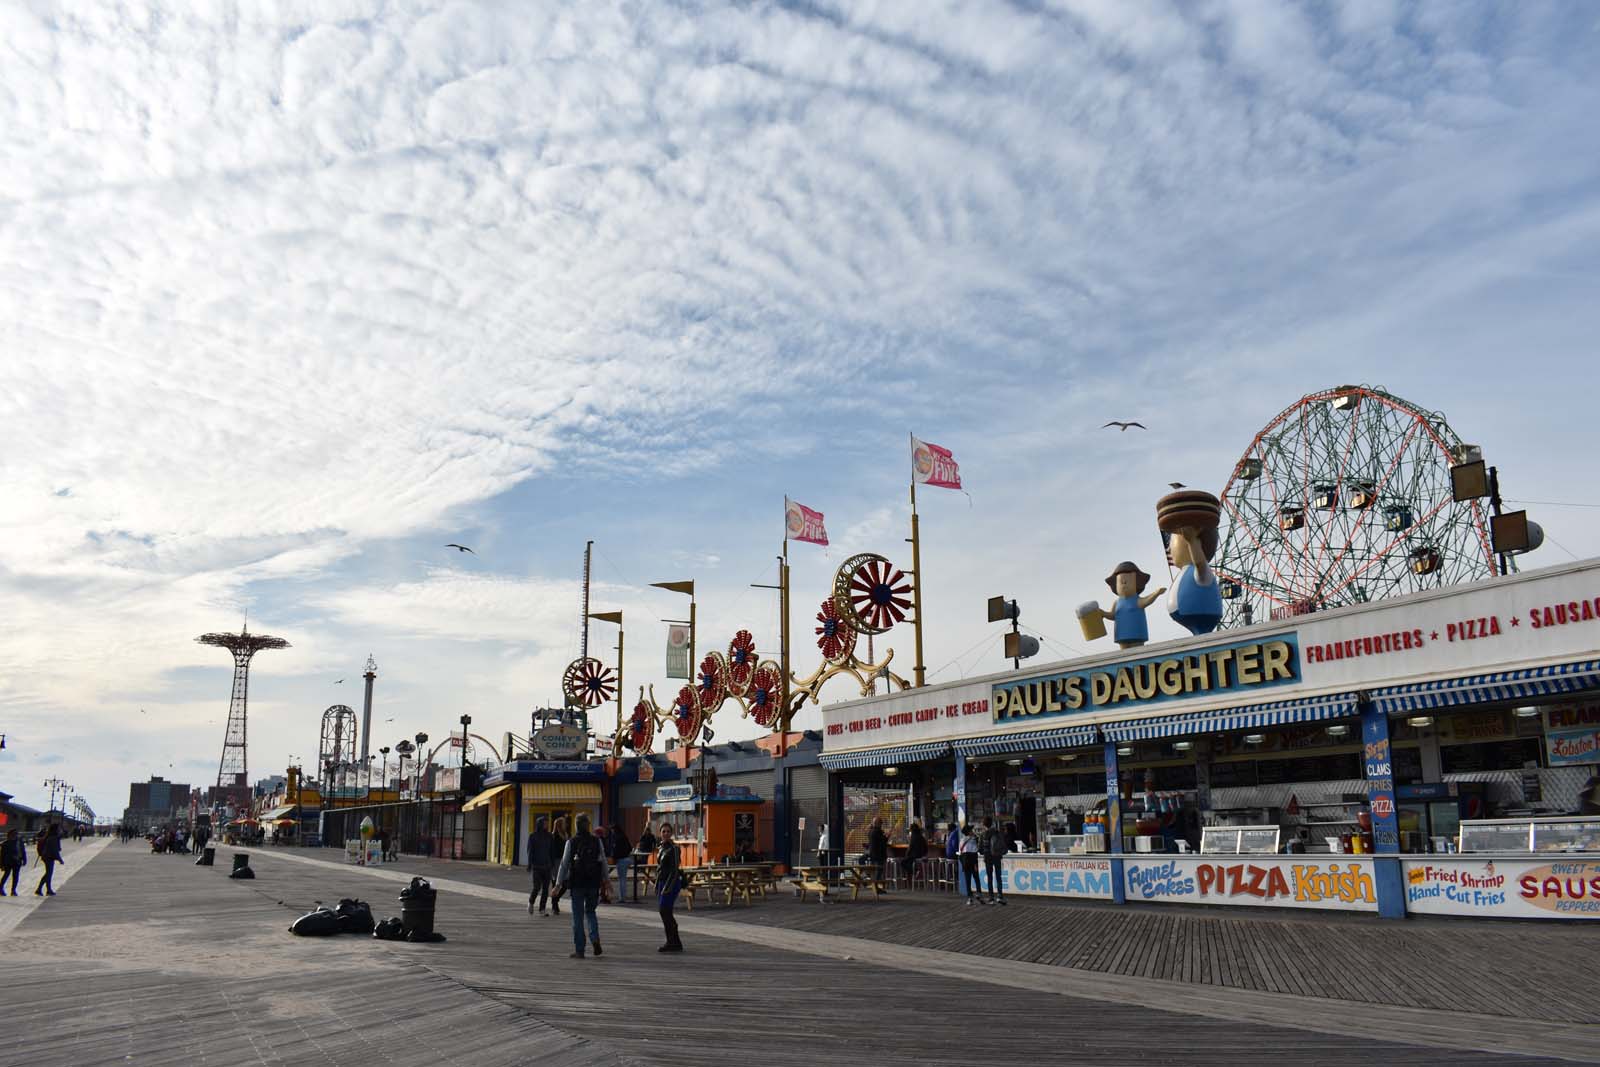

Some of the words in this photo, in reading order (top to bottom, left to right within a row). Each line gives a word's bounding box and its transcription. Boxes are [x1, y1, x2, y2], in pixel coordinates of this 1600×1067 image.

[1306, 629, 1424, 664] FRANKFURTERS
[1446, 615, 1502, 642] PIZZA
[992, 676, 1086, 721] PAUL'S
[1090, 640, 1293, 705] DAUGHTER
[849, 721, 864, 733] COLD
[865, 717, 881, 730] BEER
[888, 711, 913, 727] COTTON
[915, 707, 938, 723] CANDY
[946, 704, 959, 718] ICE
[962, 699, 988, 716] CREAM
[1366, 763, 1391, 776] CLAMS
[1368, 779, 1393, 792] FRIES
[1370, 799, 1395, 813] PIZZA
[1049, 860, 1068, 870] TAFFY
[1073, 860, 1096, 871] ITALIAN
[1127, 860, 1186, 893] Funnel
[1425, 866, 1458, 884] Fried
[1460, 871, 1505, 889] Shrimp
[1552, 863, 1587, 875] SWEET
[1014, 869, 1111, 894] CREAM
[1142, 875, 1195, 899] Cakes
[1196, 863, 1291, 899] PIZZA
[1293, 863, 1377, 903] Knish
[1408, 884, 1471, 904] Hand-Cut
[1474, 890, 1505, 907] Fries
